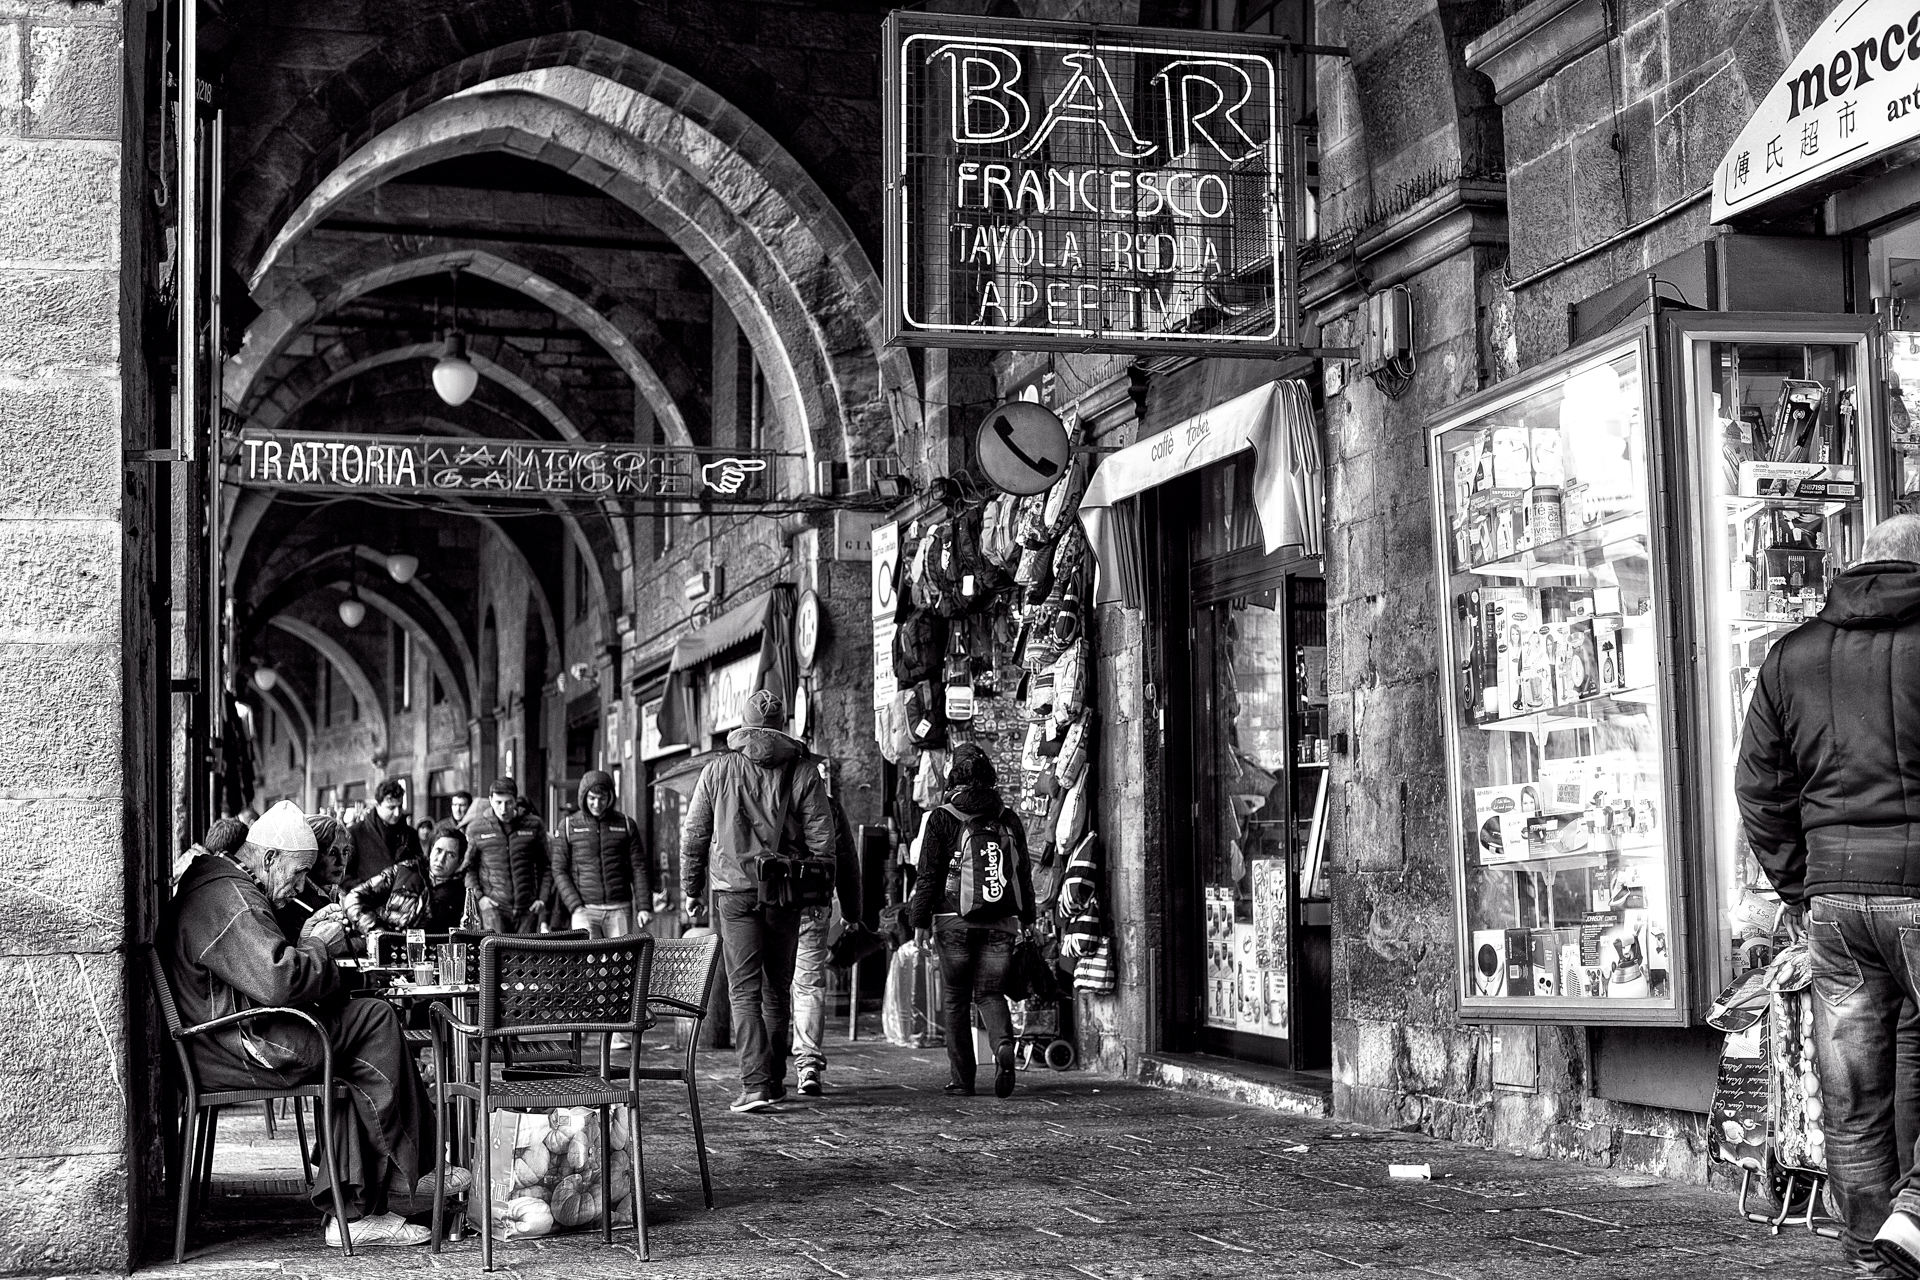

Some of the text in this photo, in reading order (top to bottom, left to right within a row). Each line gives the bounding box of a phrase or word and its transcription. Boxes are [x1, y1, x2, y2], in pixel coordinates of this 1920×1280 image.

[926, 43, 1263, 162] BAR
[958, 162, 1228, 219] FRANCESCO
[950, 223, 1083, 271] TAVOLA
[244, 440, 416, 487] TRATTORIA
[1151, 432, 1174, 462] caffè
[980, 841, 1008, 903] Carlsberg
